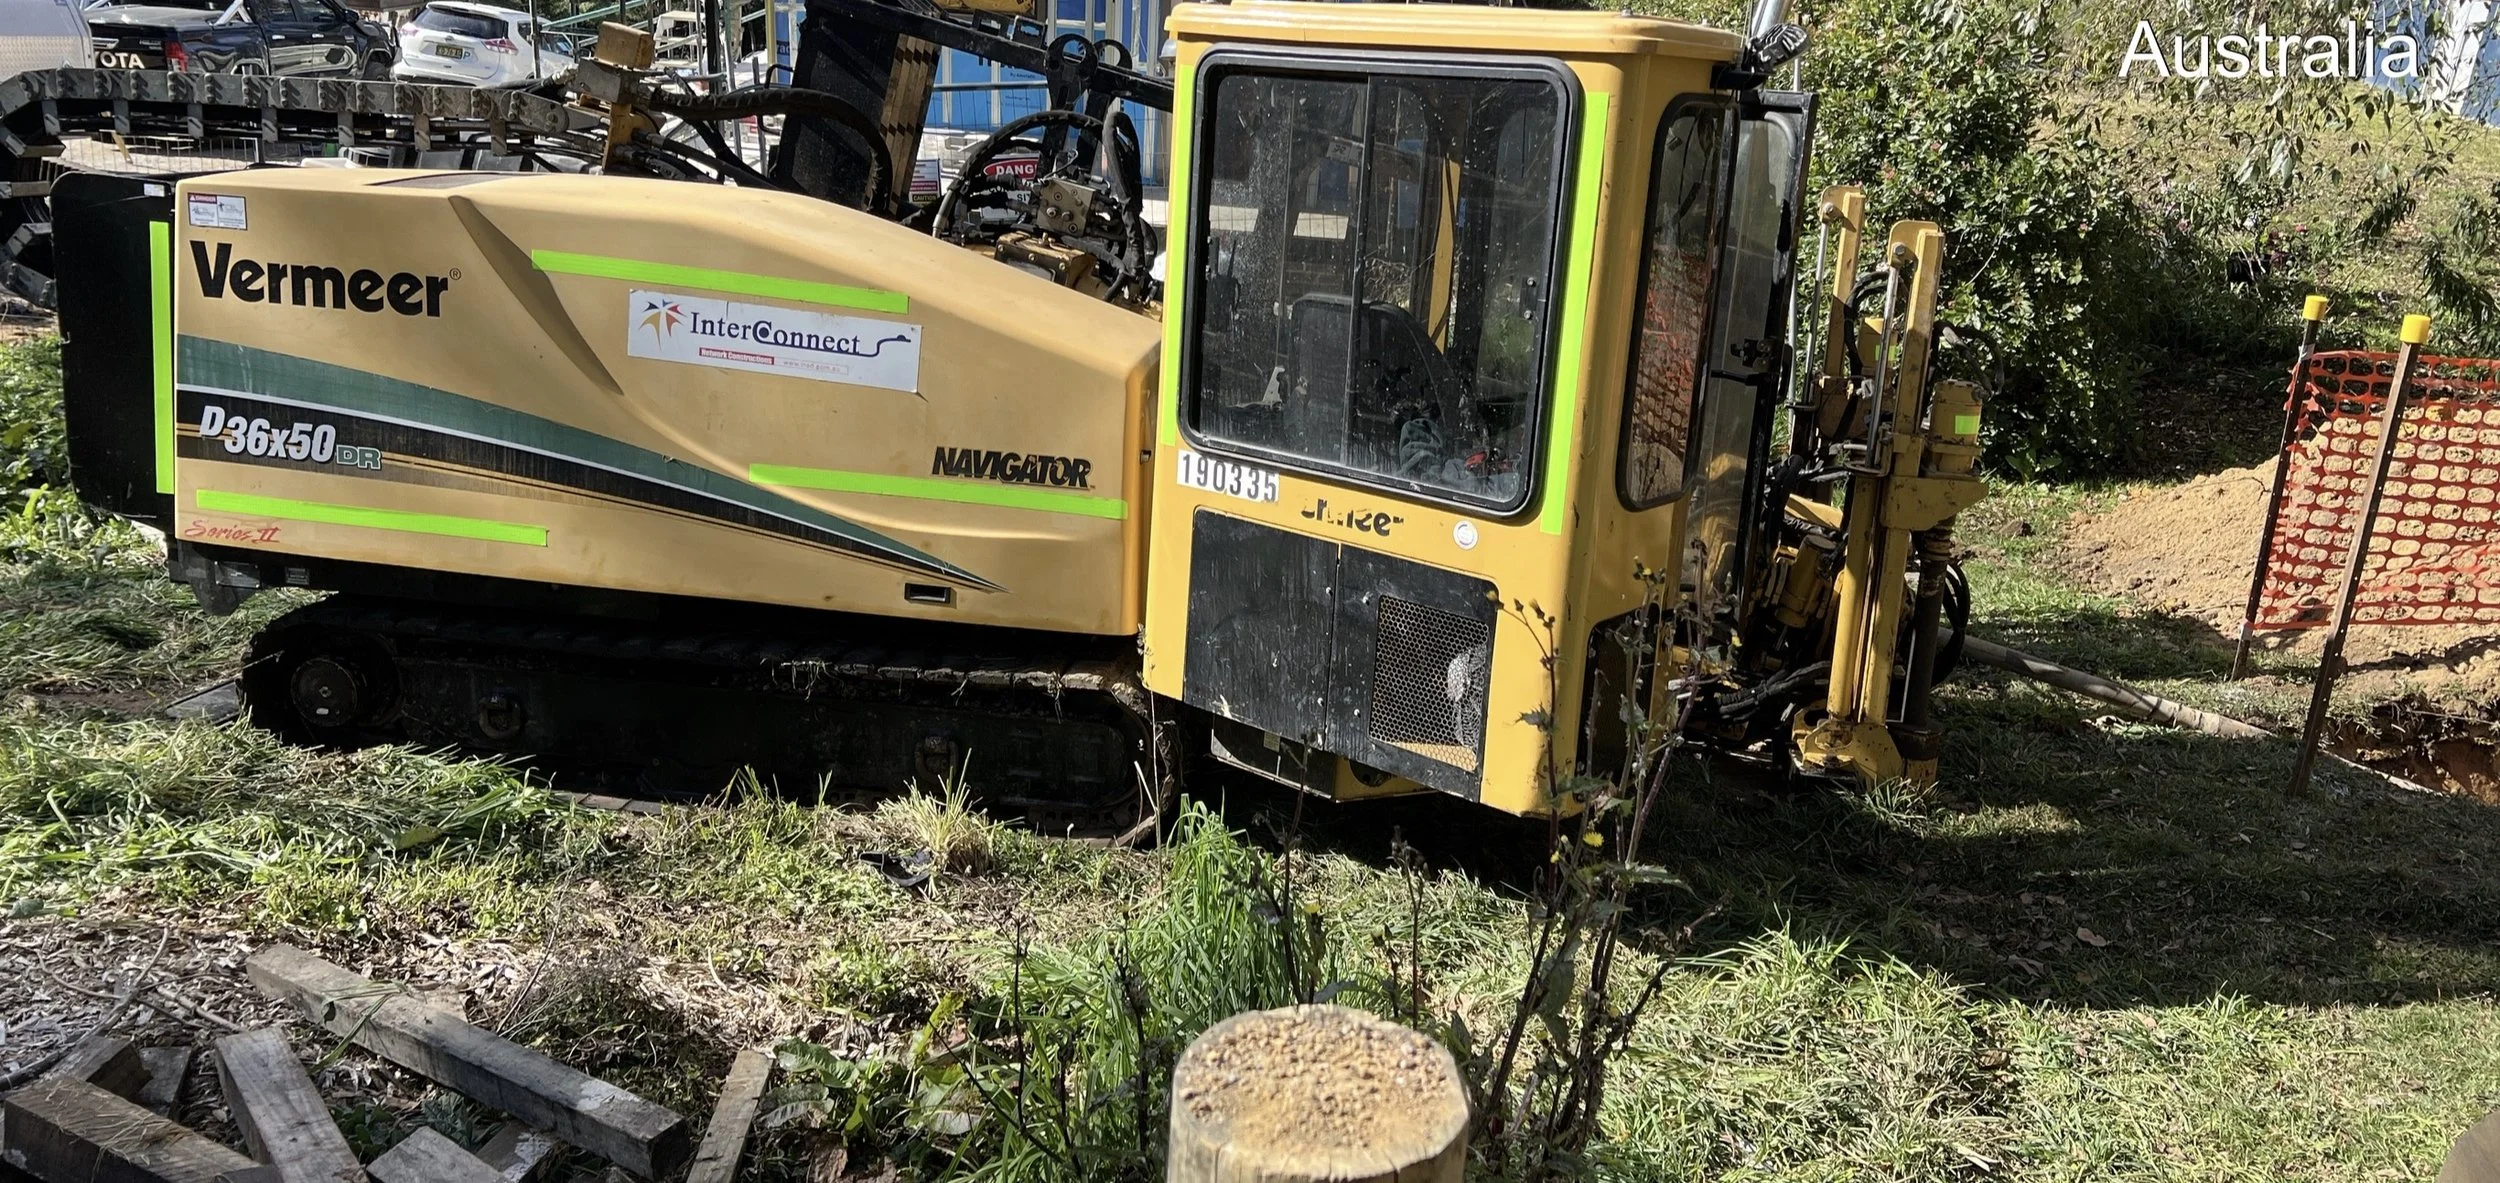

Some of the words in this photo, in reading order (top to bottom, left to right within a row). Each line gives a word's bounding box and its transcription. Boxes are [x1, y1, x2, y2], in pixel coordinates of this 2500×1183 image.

[996, 164, 1037, 175] DANG
[190, 240, 449, 317] Vermeer
[690, 312, 861, 354] InterConnect
[336, 444, 382, 470] DR
[932, 446, 1091, 488] NAVIGATOR
[1183, 453, 1277, 503] 190335
